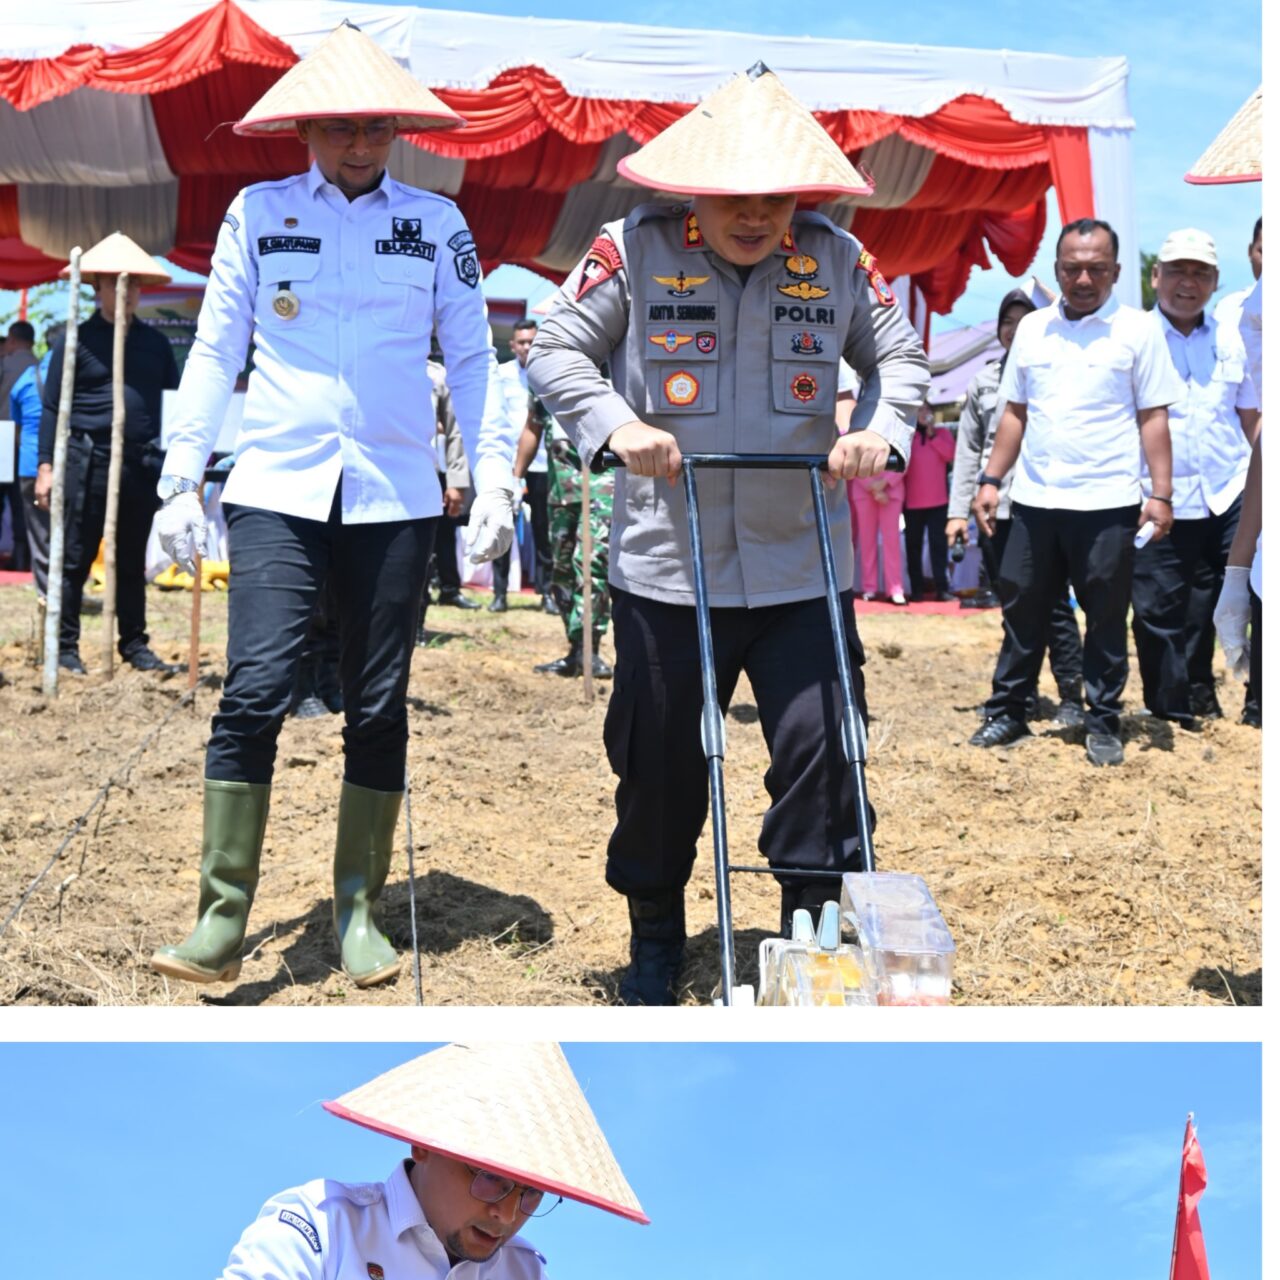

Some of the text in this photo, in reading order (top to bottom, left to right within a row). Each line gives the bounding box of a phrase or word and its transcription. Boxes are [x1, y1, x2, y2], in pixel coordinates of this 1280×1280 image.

[381, 243, 433, 258] BUPATI
[649, 305, 674, 320] ADITYA
[775, 305, 834, 325] POLRI
